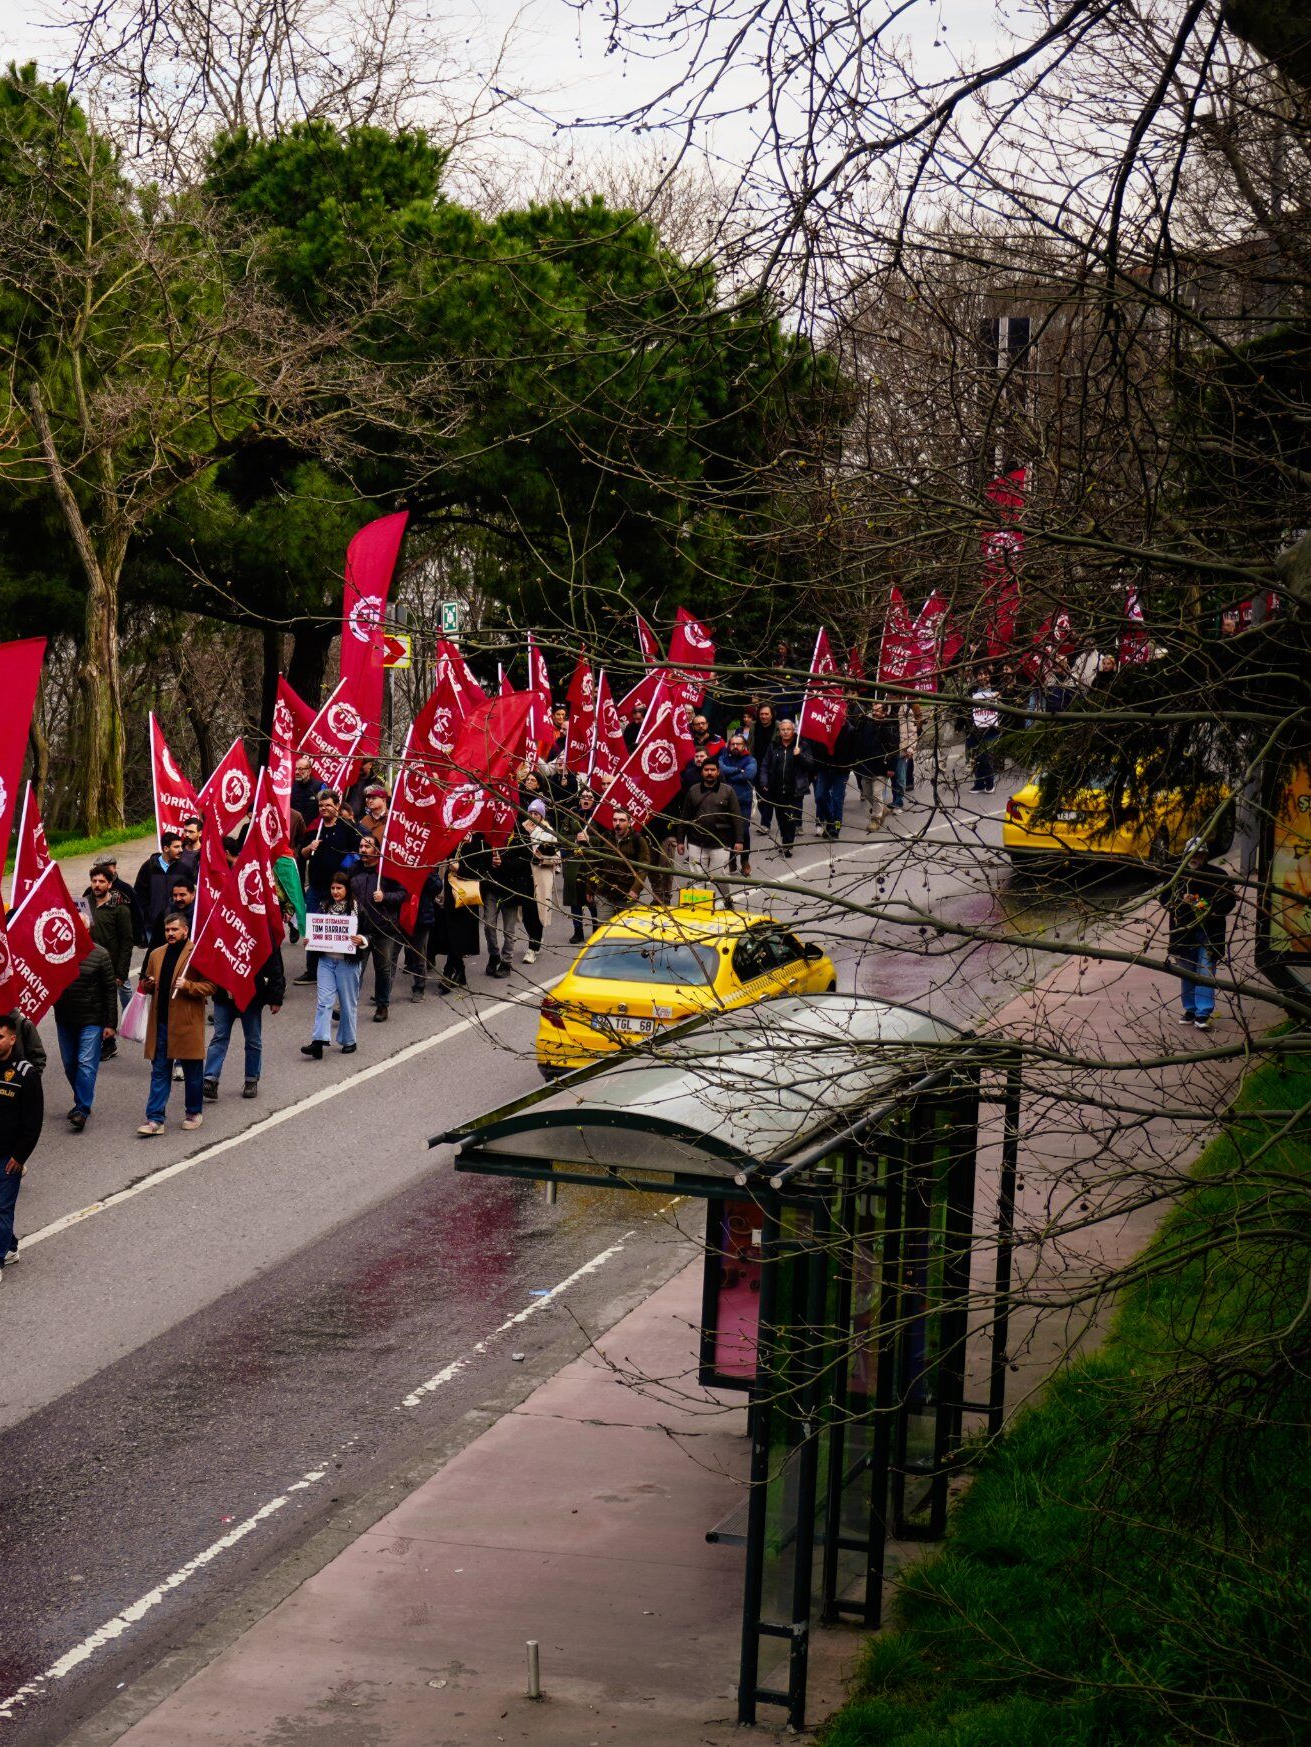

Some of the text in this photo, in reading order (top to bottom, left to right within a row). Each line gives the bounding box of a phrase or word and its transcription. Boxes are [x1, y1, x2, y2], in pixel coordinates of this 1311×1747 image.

[655, 747, 671, 765] TİP
[51, 918, 72, 942] TİP
[312, 925, 349, 934] TOM BARRACK
[18, 987, 41, 1014] İŞÇİ
[615, 1018, 632, 1030] TGL
[639, 1021, 652, 1032] 68
